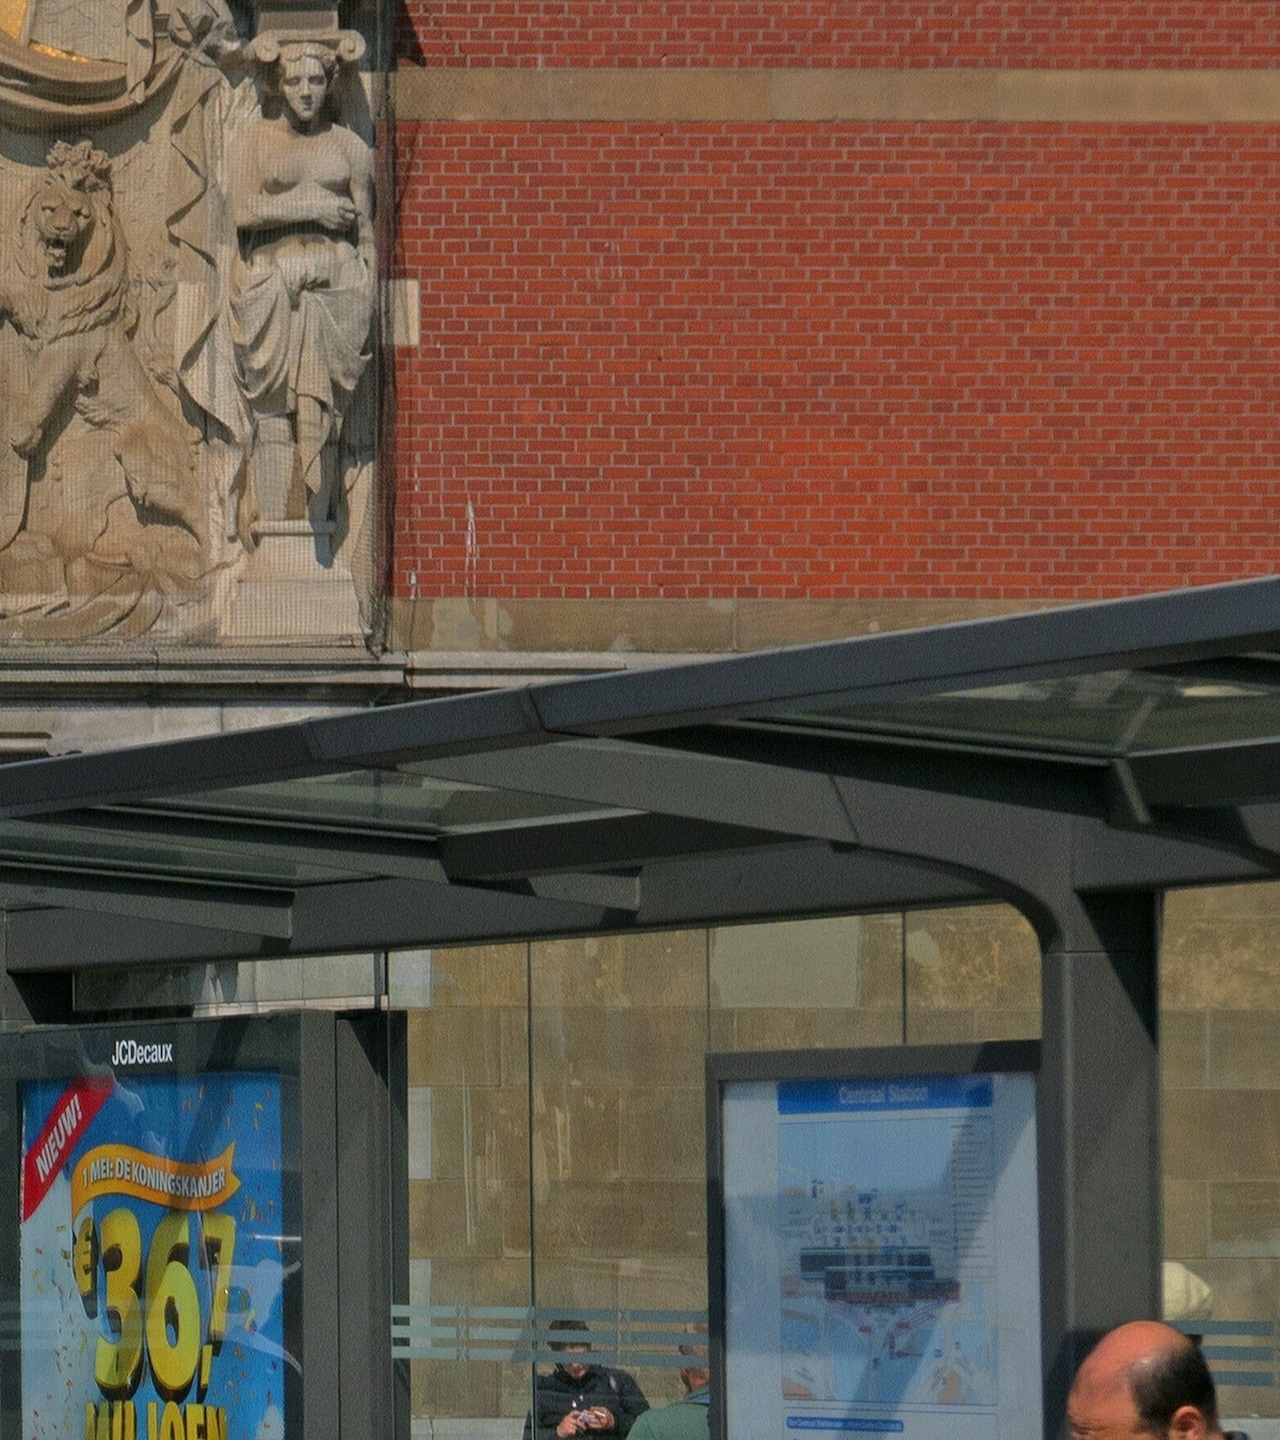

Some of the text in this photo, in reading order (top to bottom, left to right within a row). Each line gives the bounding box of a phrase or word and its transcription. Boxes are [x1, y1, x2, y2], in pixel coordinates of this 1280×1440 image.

[112, 1040, 173, 1065] JCDecaux
[35, 1093, 82, 1183] NIEUW!
[83, 1157, 226, 1198] 1 MEI: DE KONINGSKANJER
